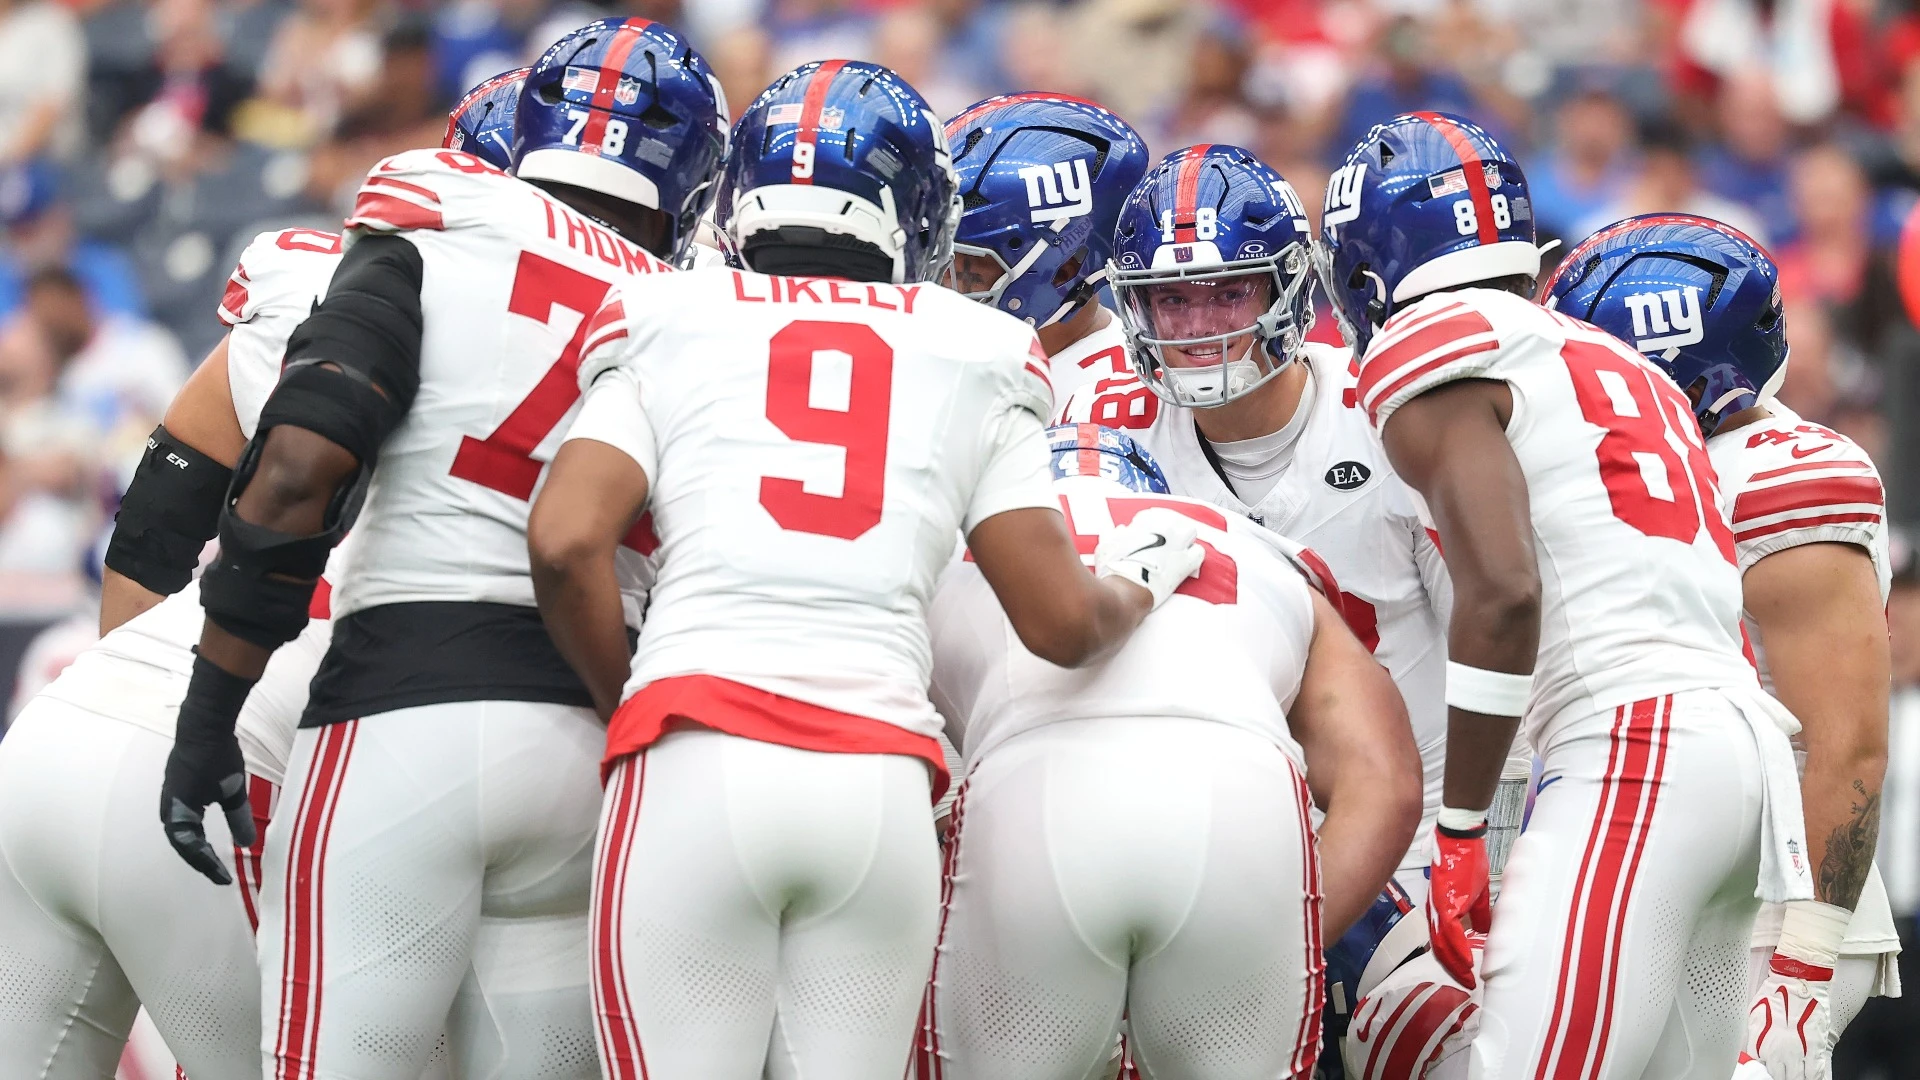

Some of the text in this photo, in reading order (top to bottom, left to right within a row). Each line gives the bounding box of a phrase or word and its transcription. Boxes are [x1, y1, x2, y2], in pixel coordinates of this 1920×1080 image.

[561, 109, 629, 157] 78
[791, 142, 816, 178] 9
[1161, 207, 1218, 242] 18
[1452, 194, 1512, 236] 88
[732, 271, 921, 314] LIKELY
[449, 250, 613, 501] 7
[759, 320, 893, 541] 9
[1058, 450, 1121, 482] 45
[1331, 465, 1366, 485] EA
